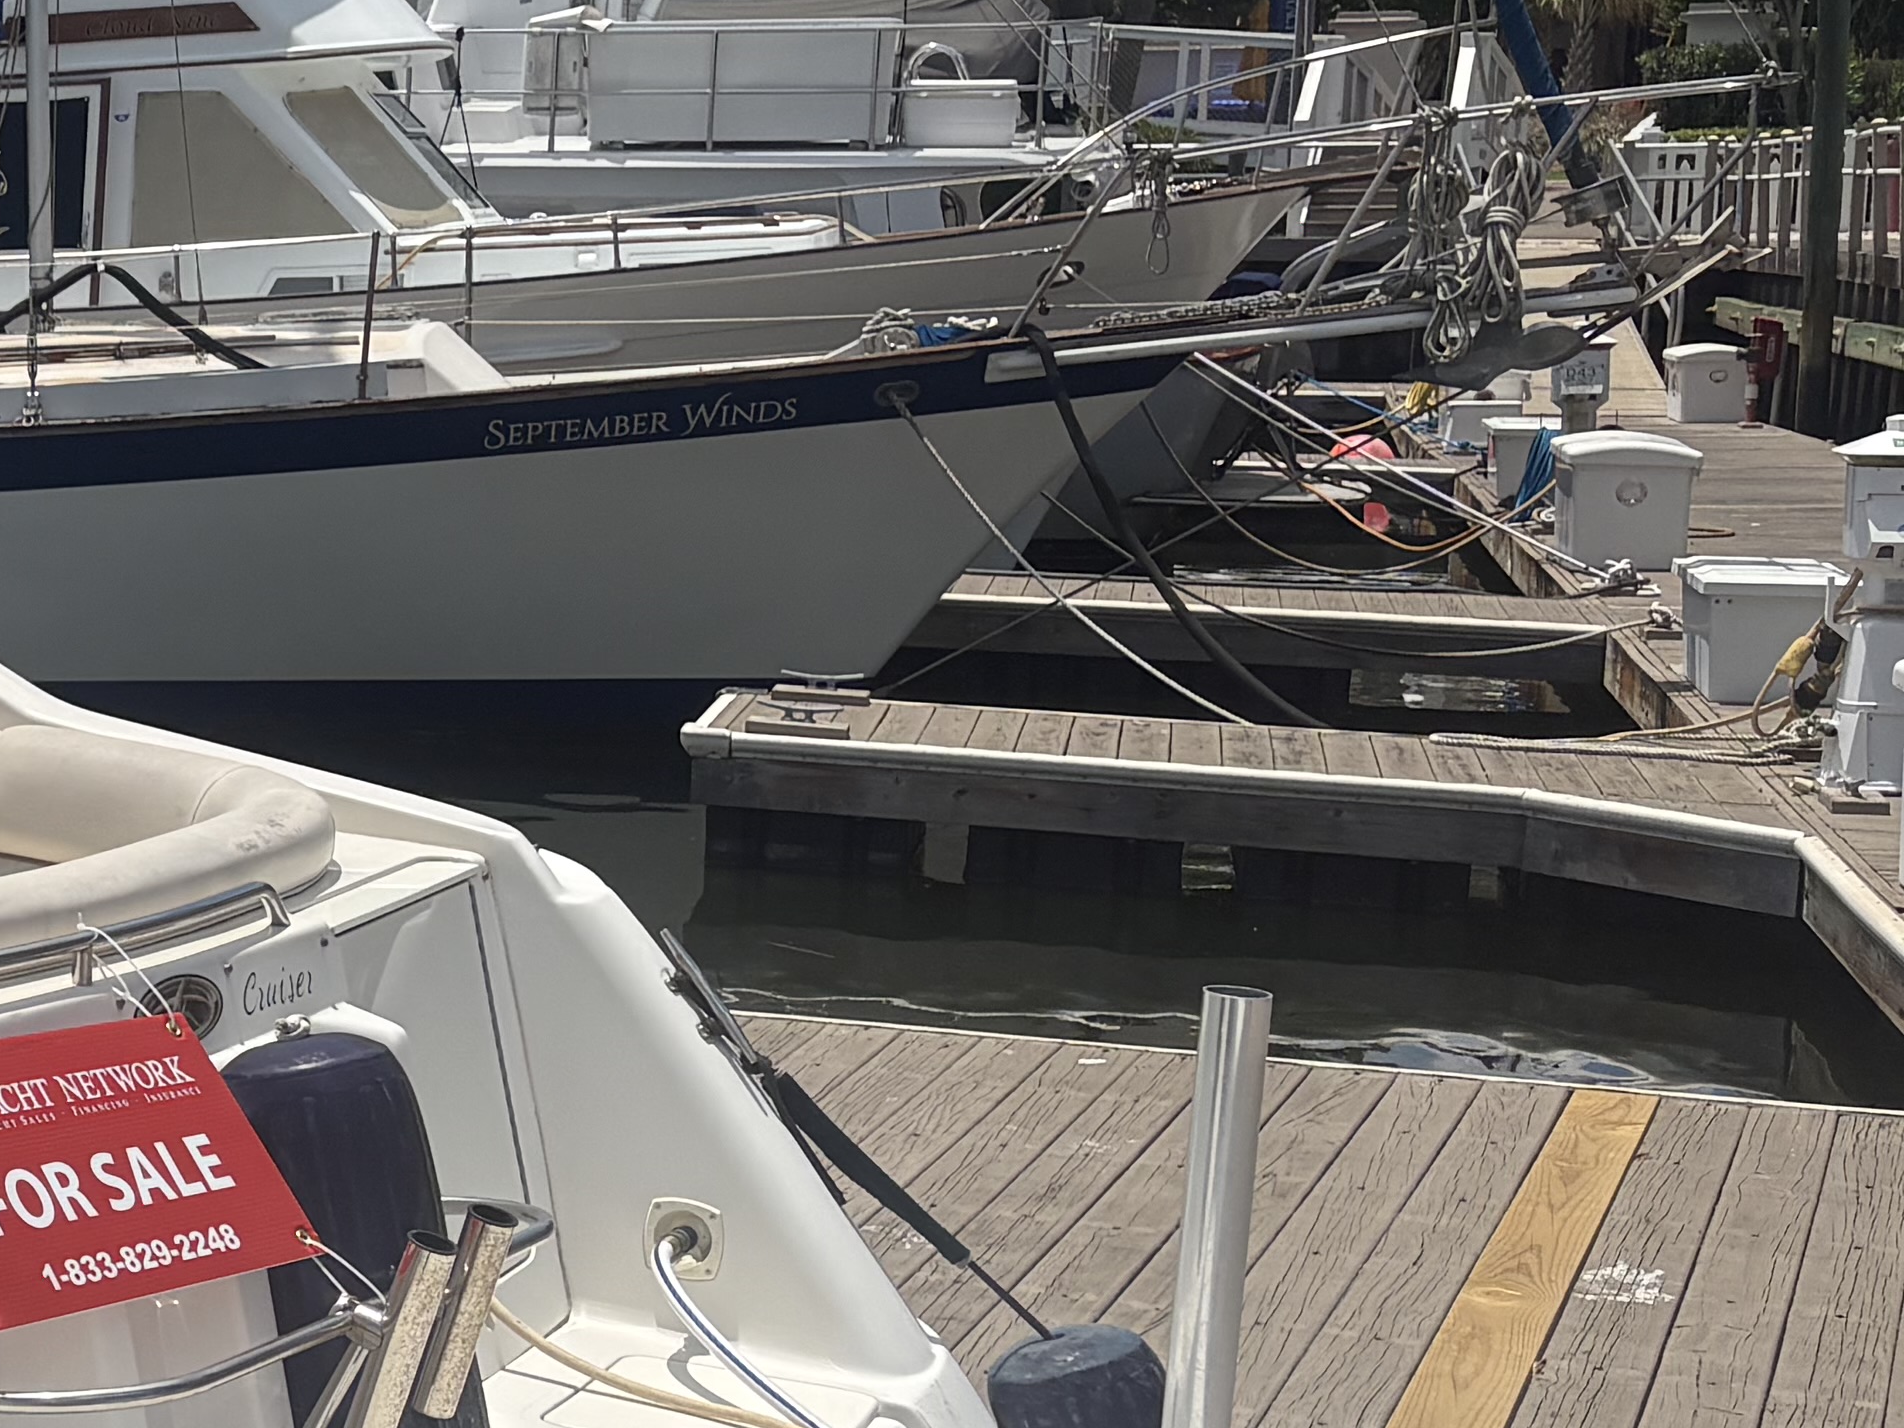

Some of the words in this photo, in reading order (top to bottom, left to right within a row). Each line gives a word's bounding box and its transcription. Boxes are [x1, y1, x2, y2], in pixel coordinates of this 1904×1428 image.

[483, 411, 670, 451] SEPTEMBER
[243, 966, 312, 1015] Cruiser
[53, 1055, 195, 1103] NETWORK
[90, 1133, 237, 1211] SALE
[42, 1224, 241, 1290] 1-833-829-2248
